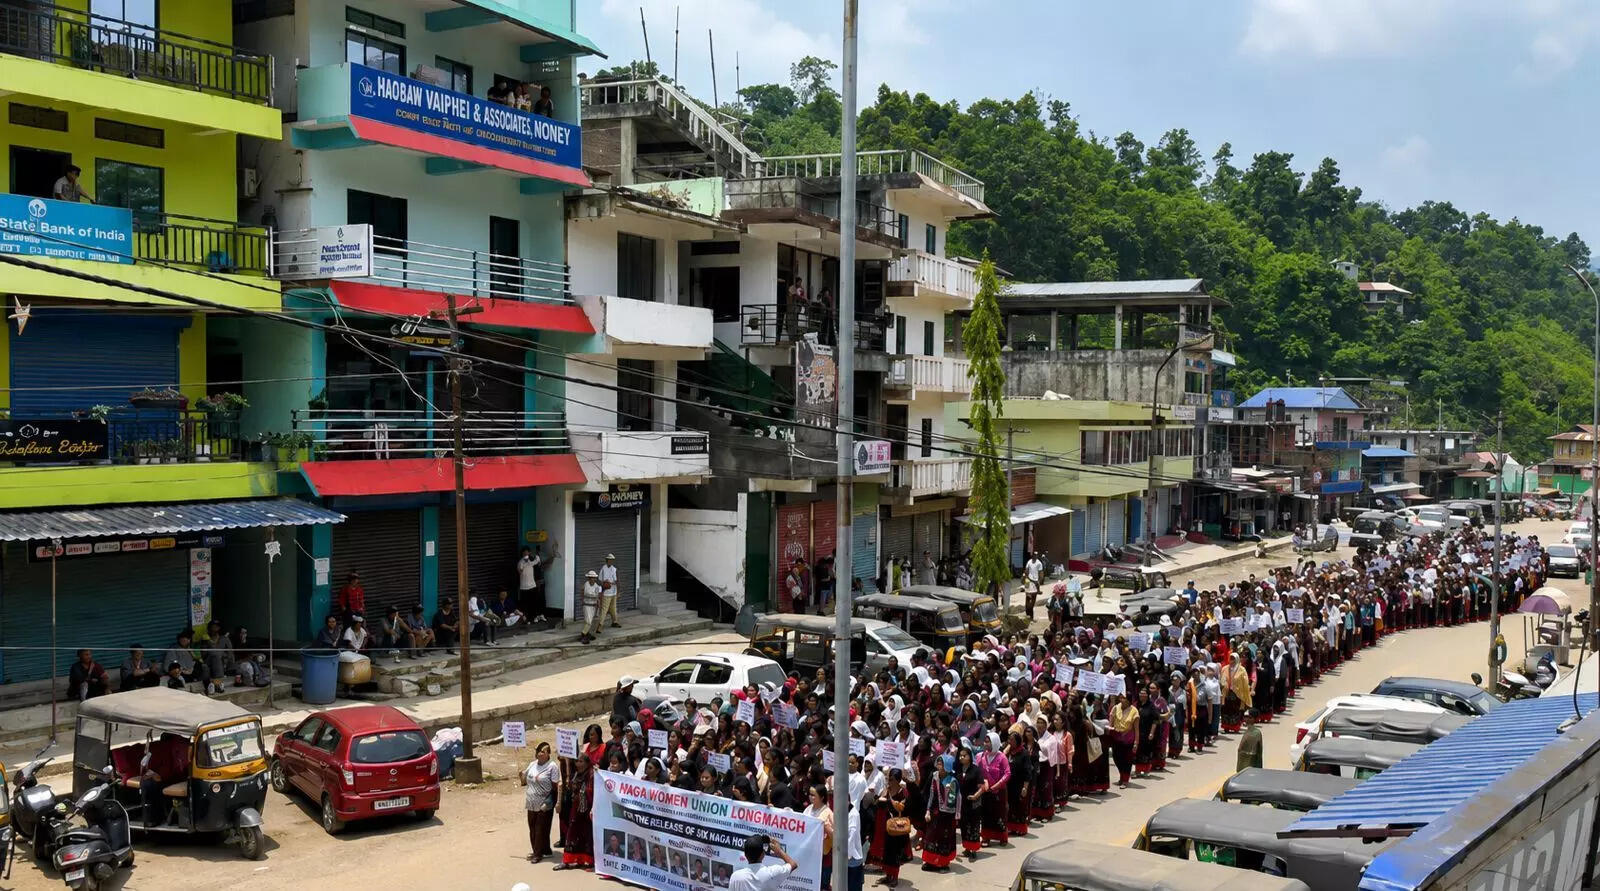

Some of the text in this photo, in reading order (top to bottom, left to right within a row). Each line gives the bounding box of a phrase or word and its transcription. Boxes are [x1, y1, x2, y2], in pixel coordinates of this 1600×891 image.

[377, 76, 422, 107] HAOBAW
[426, 89, 470, 120] VAIPHEI
[473, 105, 481, 123] &
[483, 107, 533, 139] ASSOCIATES,
[534, 120, 571, 146] NONEY
[0, 217, 126, 241] State Bank of India
[619, 782, 647, 799] NAGA
[649, 789, 689, 808] WOMEN
[691, 797, 728, 817] UNION
[730, 805, 806, 834] LONGMARCH
[634, 814, 650, 825] THE
[650, 817, 684, 833] RELEASE
[685, 825, 695, 836] OF
[696, 829, 709, 840] SIX
